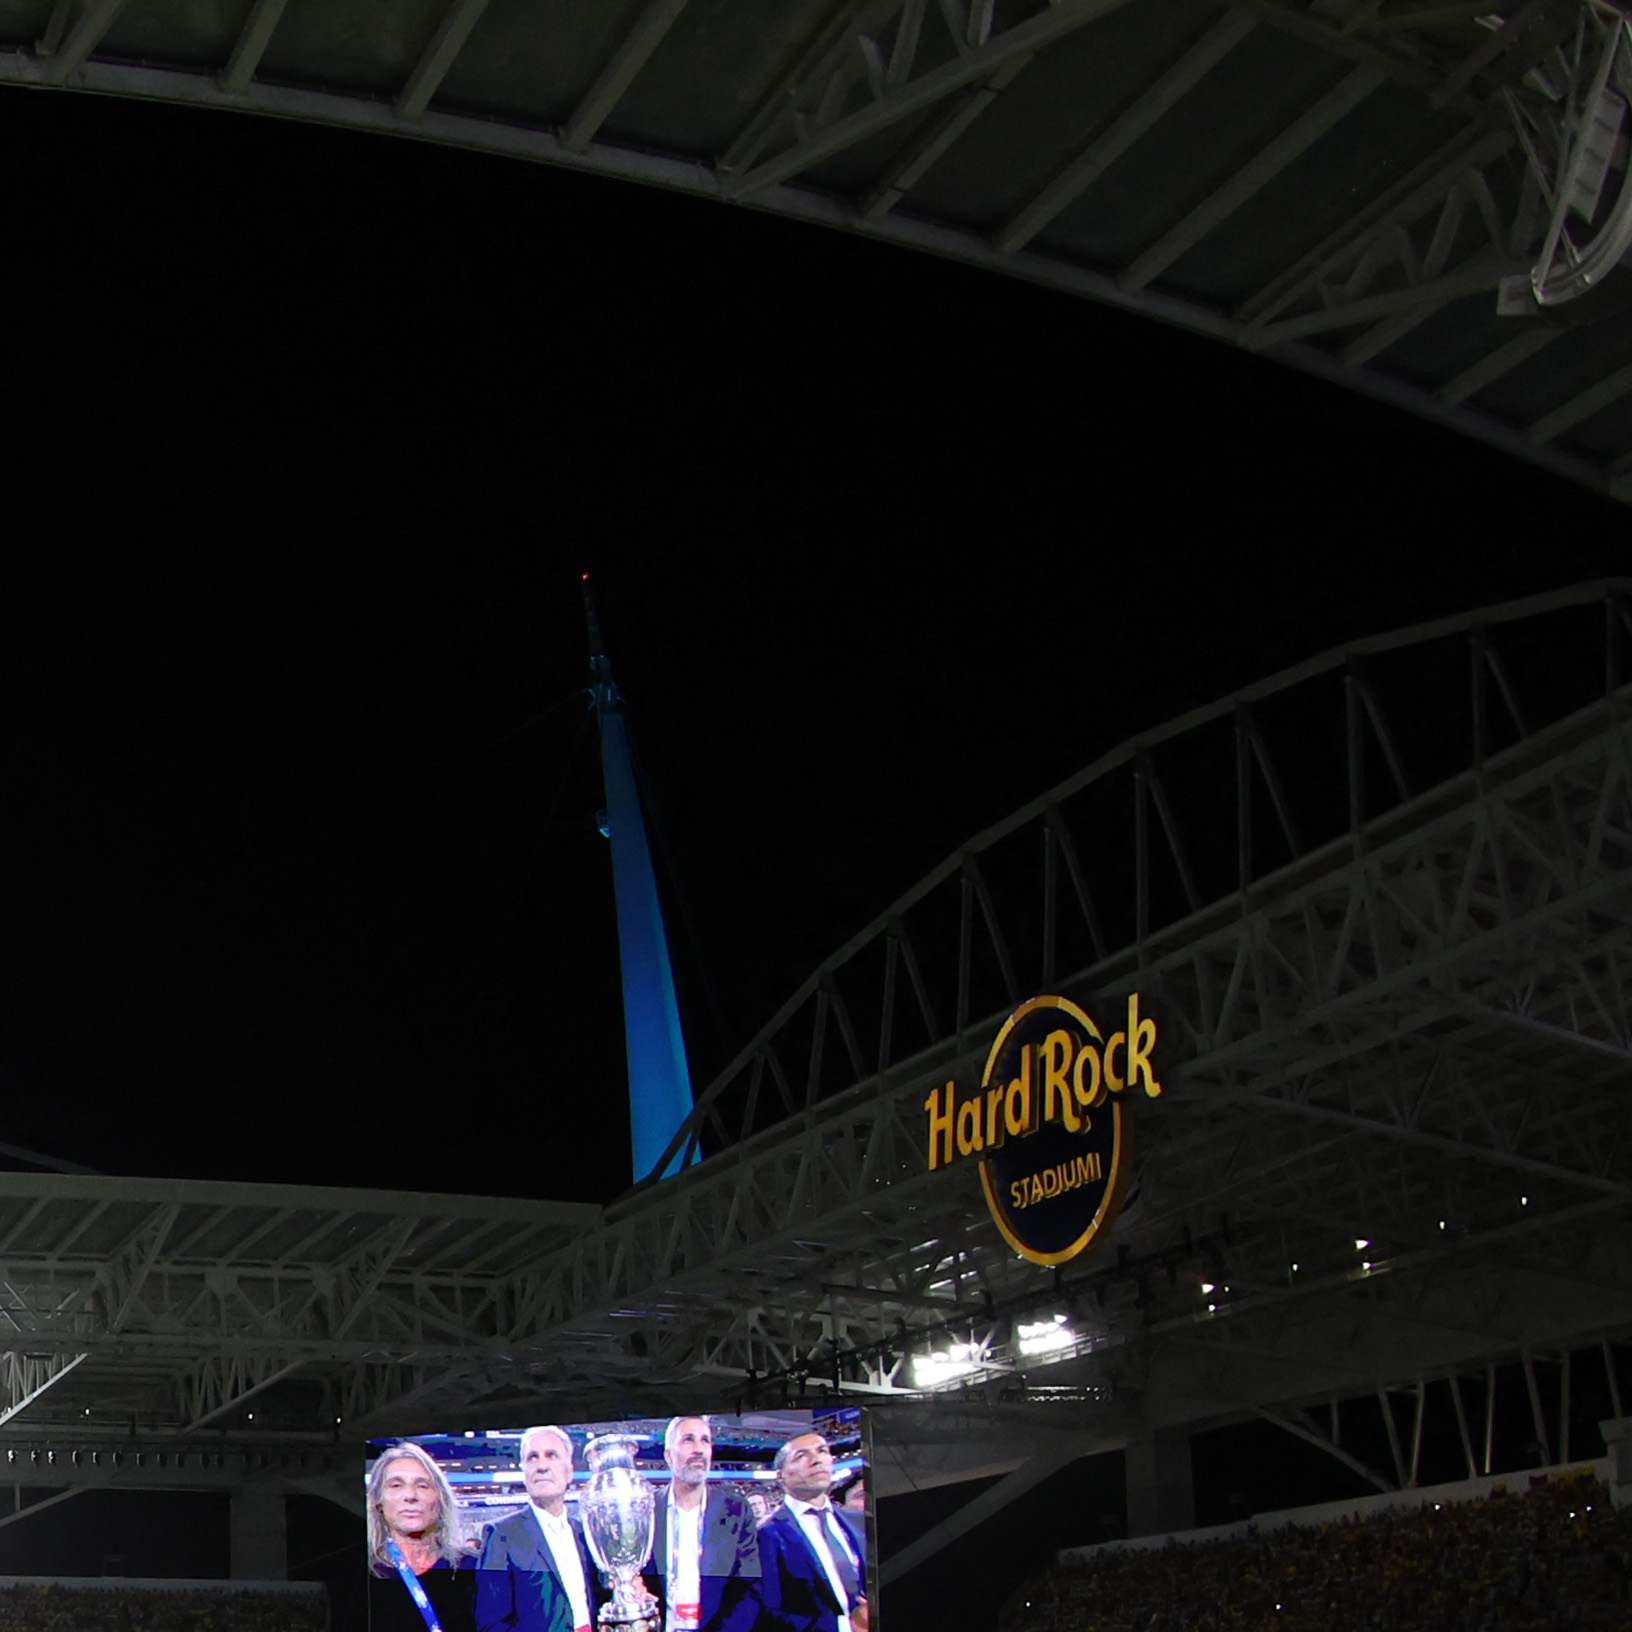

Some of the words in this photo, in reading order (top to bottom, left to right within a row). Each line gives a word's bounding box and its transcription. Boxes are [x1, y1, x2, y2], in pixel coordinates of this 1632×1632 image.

[924, 1043, 1033, 1171] Hard
[1038, 992, 1161, 1133] Rock
[1010, 1152, 1102, 1209] STADIUM
